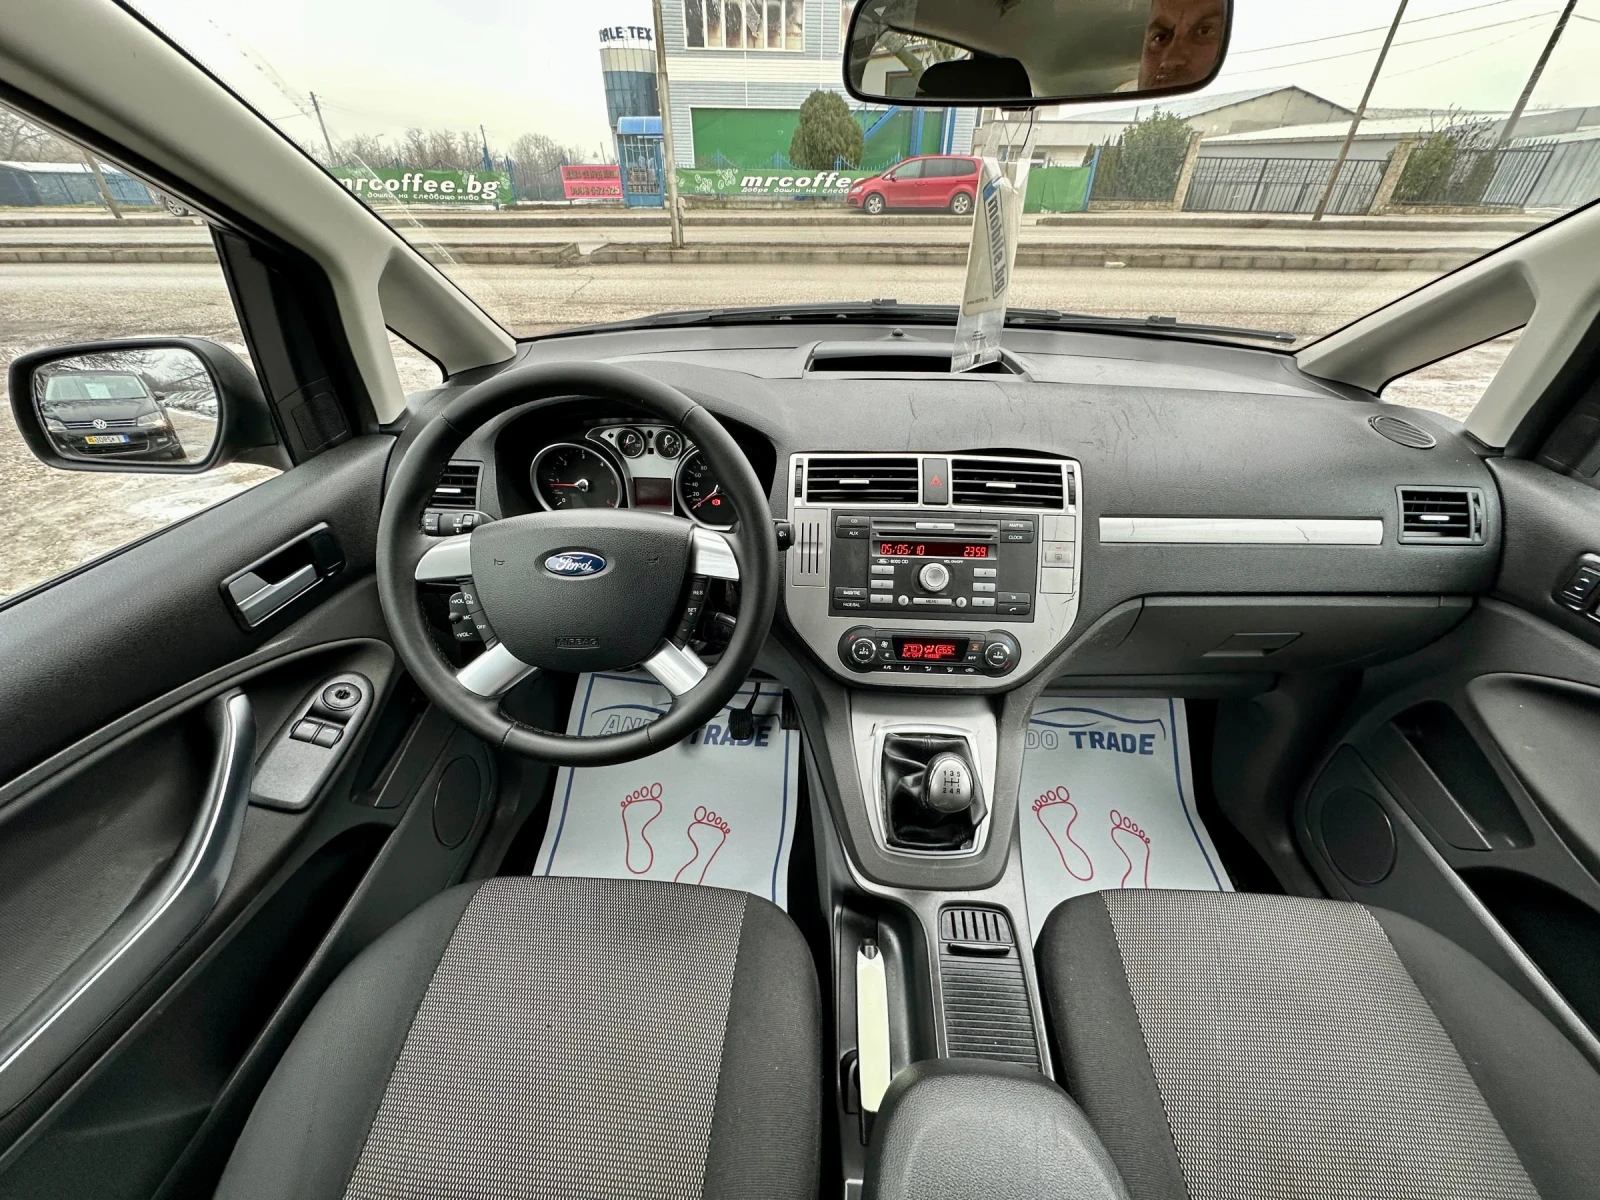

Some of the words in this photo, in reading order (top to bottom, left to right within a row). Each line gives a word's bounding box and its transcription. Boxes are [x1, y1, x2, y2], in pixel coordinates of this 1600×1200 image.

[627, 26, 652, 41] TEX
[413, 193, 456, 201] следващо
[987, 195, 1006, 294] mobile.bg
[556, 555, 595, 572] Ford
[558, 638, 598, 646] AIRBAG
[1069, 731, 1156, 756] TRADE
